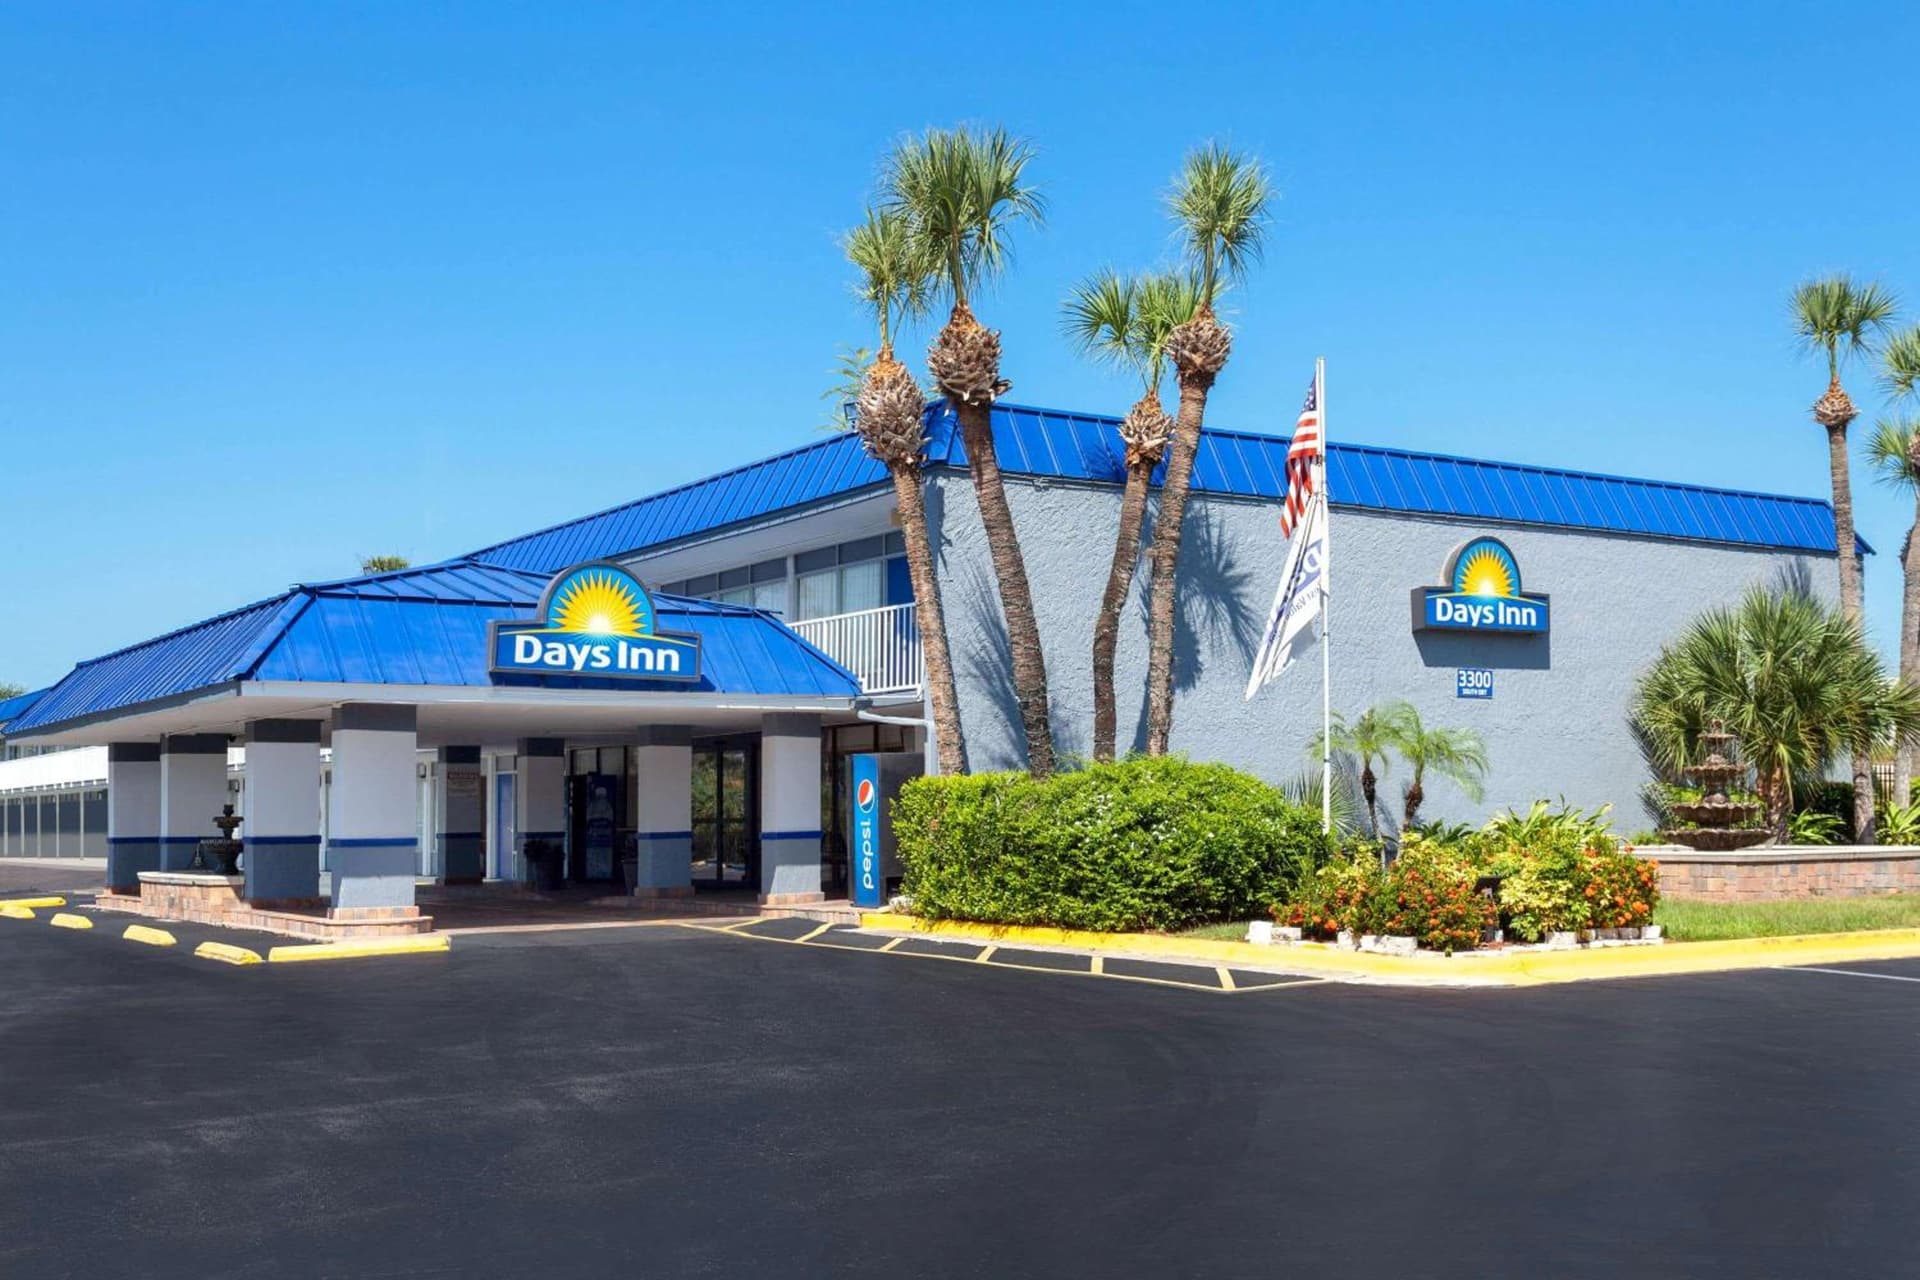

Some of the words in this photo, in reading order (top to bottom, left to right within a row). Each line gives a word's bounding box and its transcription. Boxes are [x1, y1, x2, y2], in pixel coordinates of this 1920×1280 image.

[1435, 598, 1494, 627] Days
[1498, 601, 1537, 626] Inn
[514, 634, 611, 671] Days
[617, 640, 680, 672] Inn
[1458, 670, 1491, 688] 3300
[860, 818, 874, 889] pepsi
